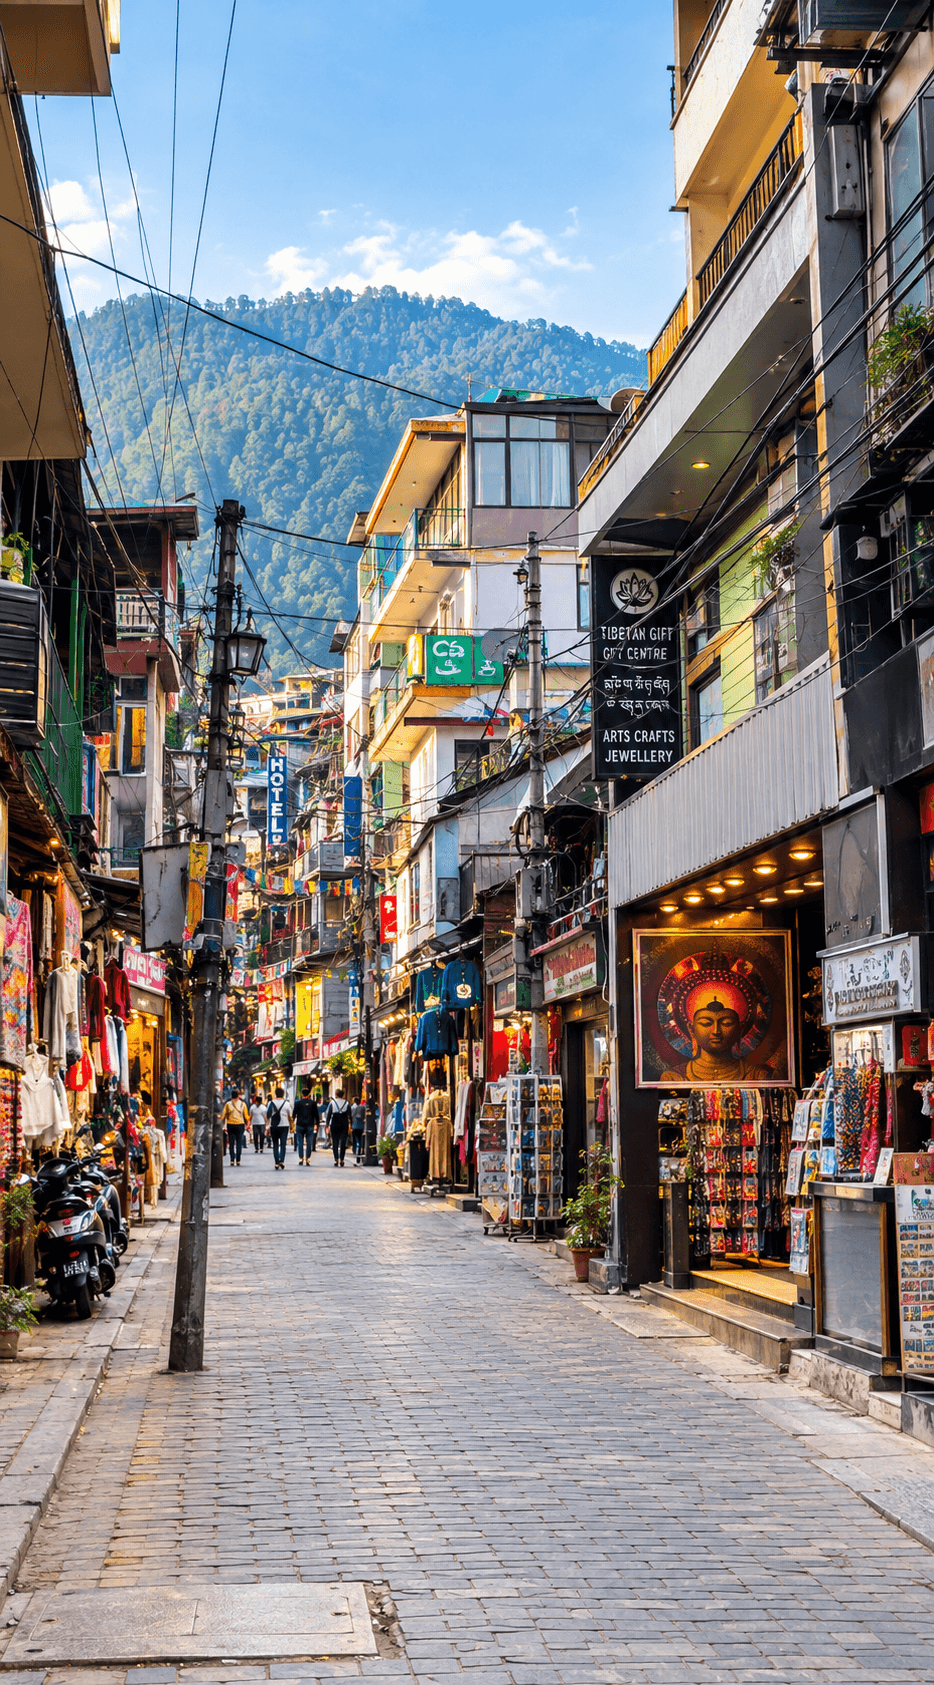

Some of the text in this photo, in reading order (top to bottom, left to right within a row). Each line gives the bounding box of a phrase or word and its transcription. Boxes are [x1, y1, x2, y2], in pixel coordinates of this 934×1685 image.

[627, 647, 667, 660] CENTRE
[603, 729, 675, 743] ARTS CRAFTS
[605, 749, 673, 763] JEWELLERY
